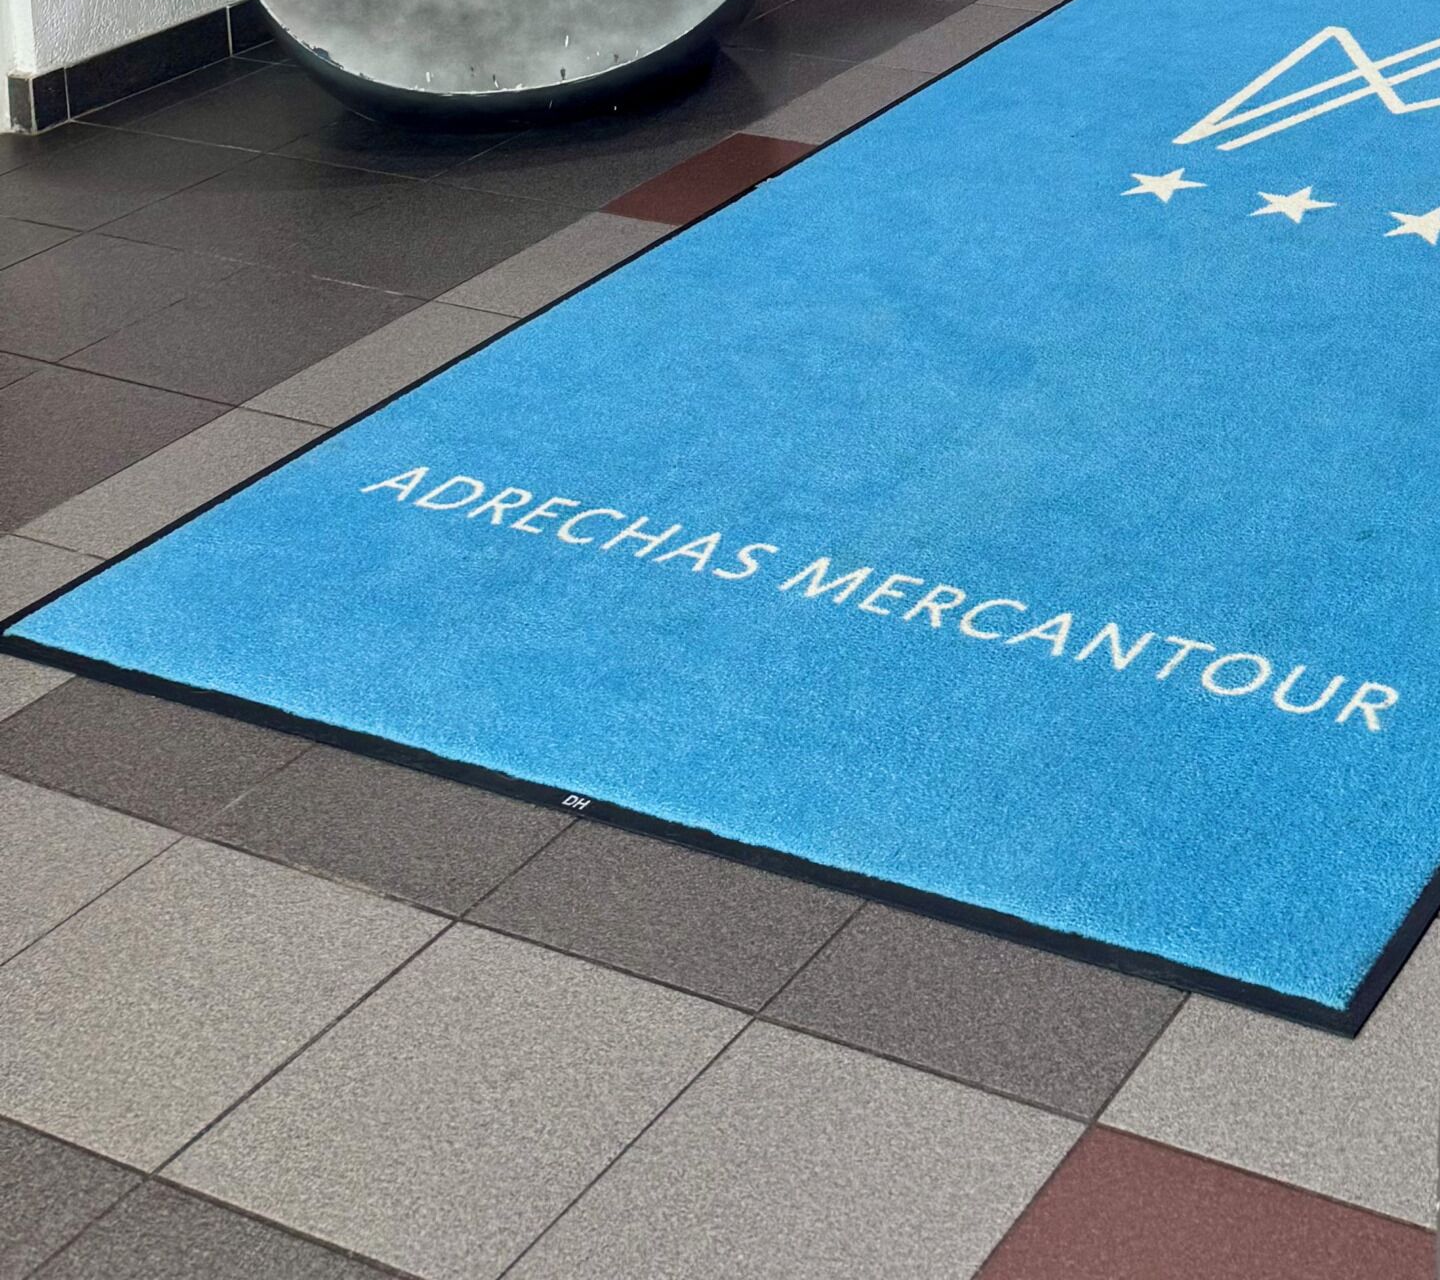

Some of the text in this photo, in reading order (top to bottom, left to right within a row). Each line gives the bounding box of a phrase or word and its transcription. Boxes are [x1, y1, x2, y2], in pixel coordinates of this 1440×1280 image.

[361, 466, 1401, 732] ADRECHAS MERCANTOUR
[561, 794, 592, 811] DH
